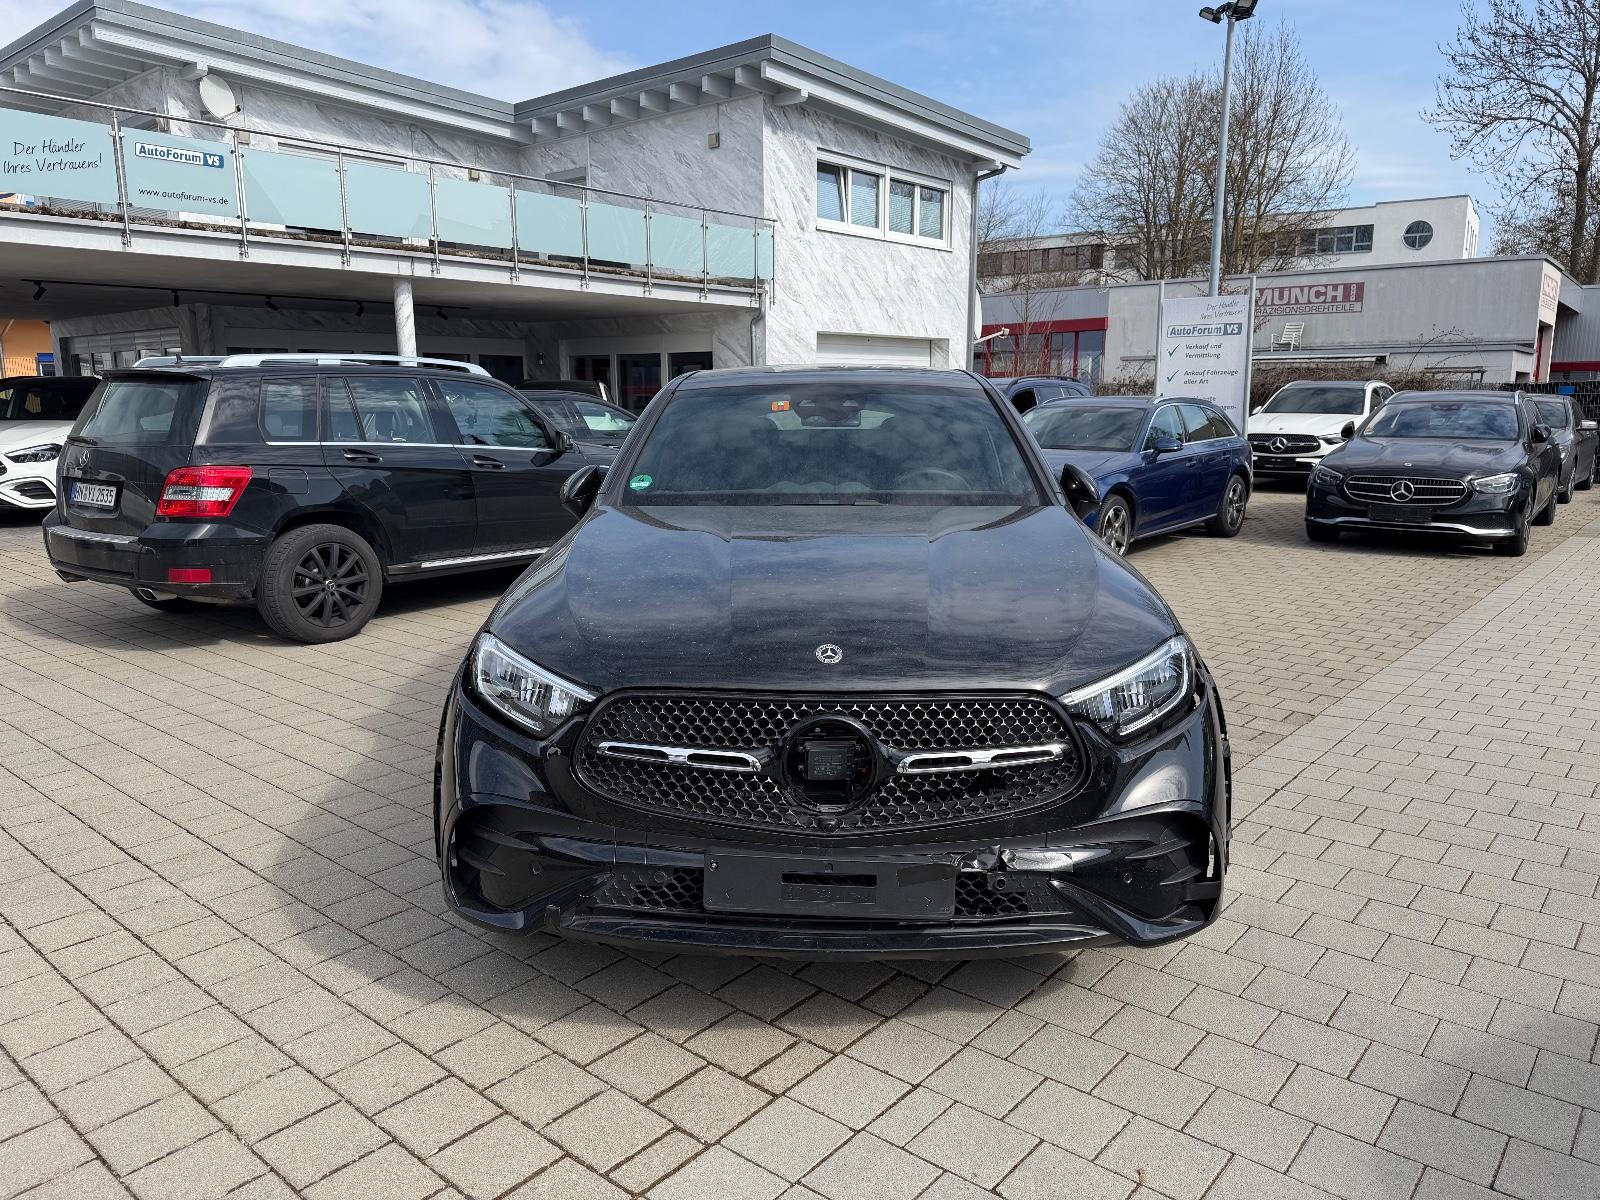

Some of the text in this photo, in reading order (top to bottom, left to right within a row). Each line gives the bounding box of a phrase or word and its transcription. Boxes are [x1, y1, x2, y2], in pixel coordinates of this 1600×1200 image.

[13, 138, 86, 155] Der Händler
[138, 145, 220, 166] AutoForum VS
[3, 153, 102, 174] Ihres Vertrauens!
[138, 188, 229, 205] www.autoforum-vs.de
[1169, 324, 1239, 337] AutoForum VS
[1185, 343, 1208, 351] Verkauf
[1185, 352, 1221, 360] Vermittlung
[1206, 369, 1239, 378] Fahrzeuge
